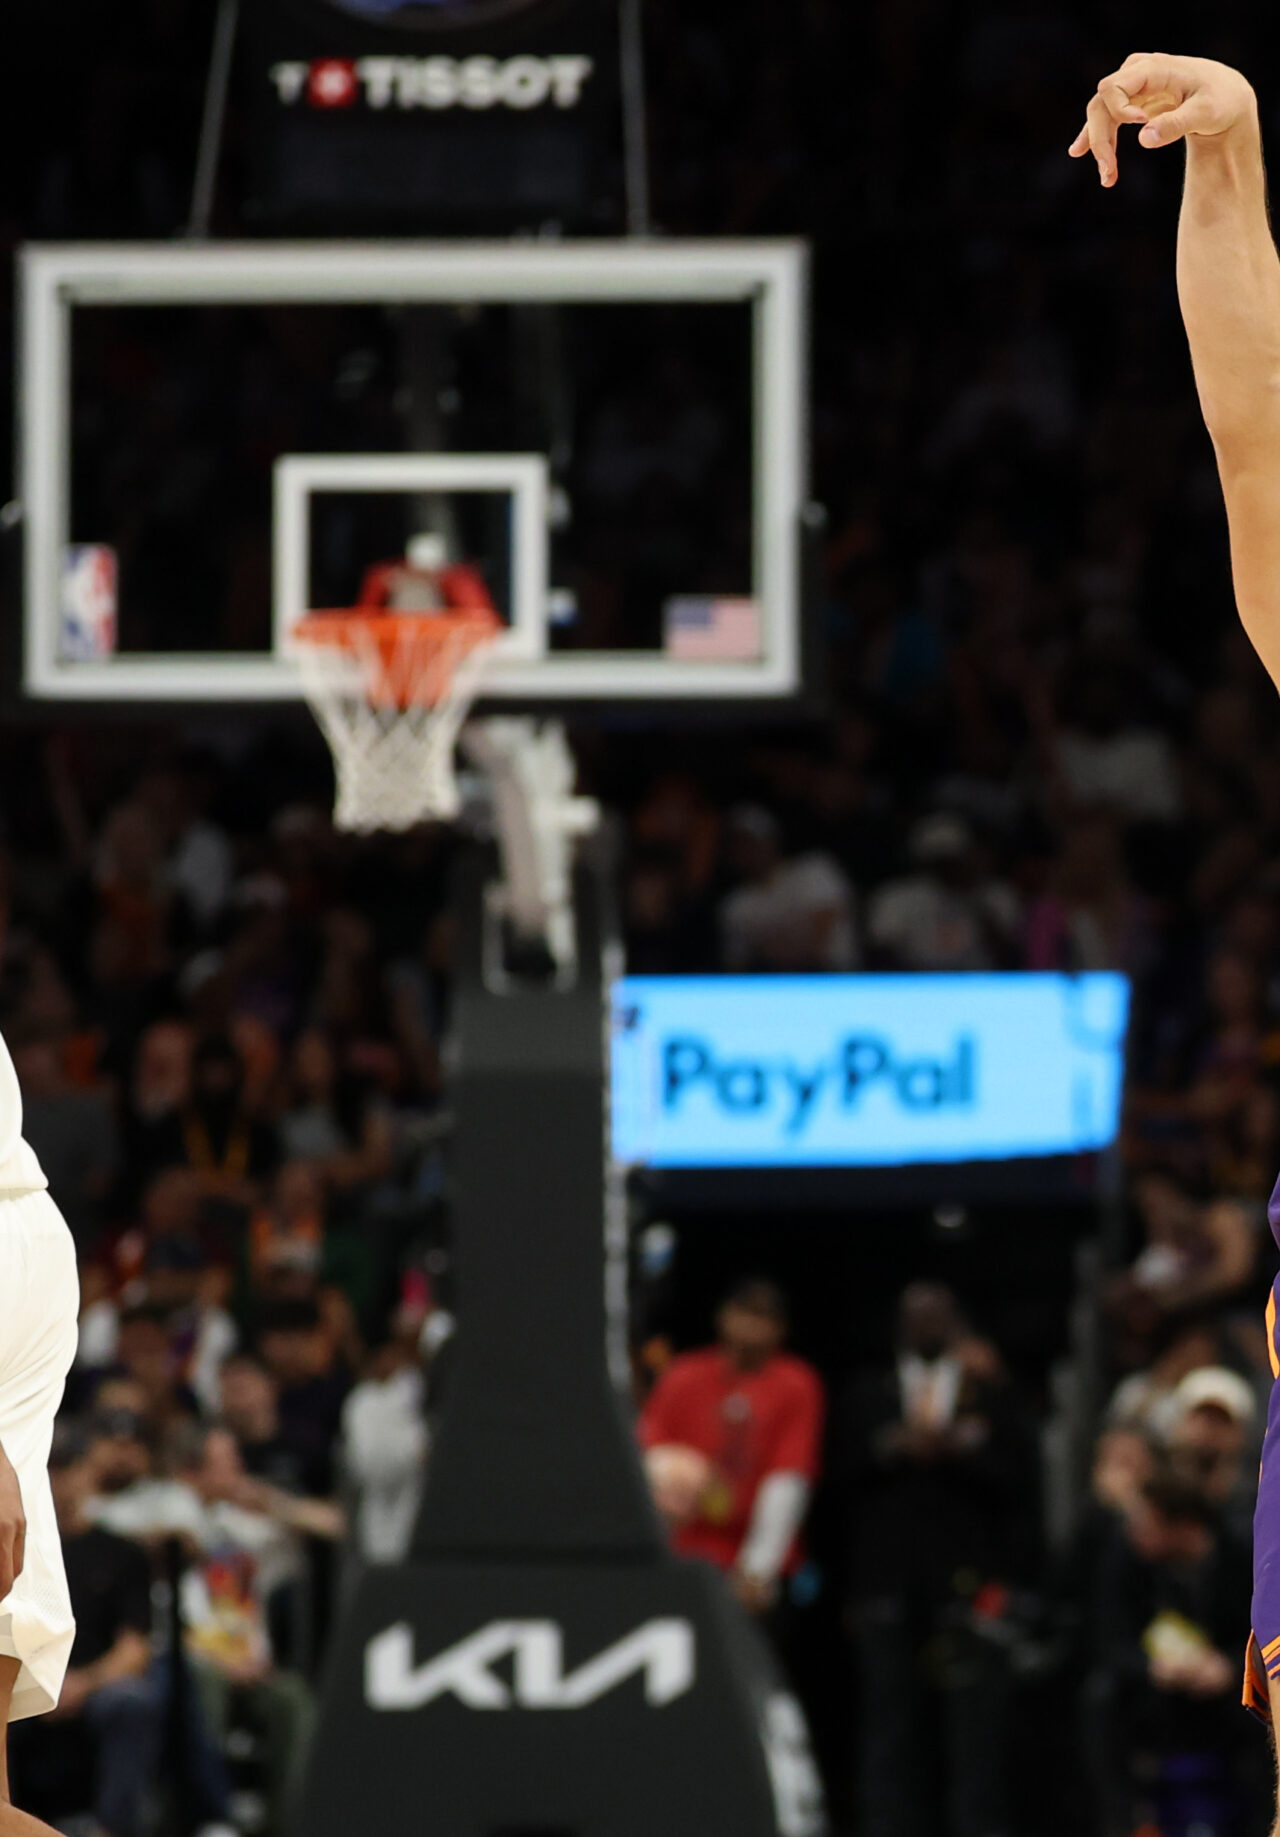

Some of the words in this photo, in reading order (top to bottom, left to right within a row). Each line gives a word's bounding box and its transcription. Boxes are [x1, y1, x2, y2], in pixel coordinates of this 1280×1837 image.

[357, 55, 593, 109] TISSOT
[664, 1031, 975, 1140] PayPal
[364, 1618, 696, 1710] KIA
